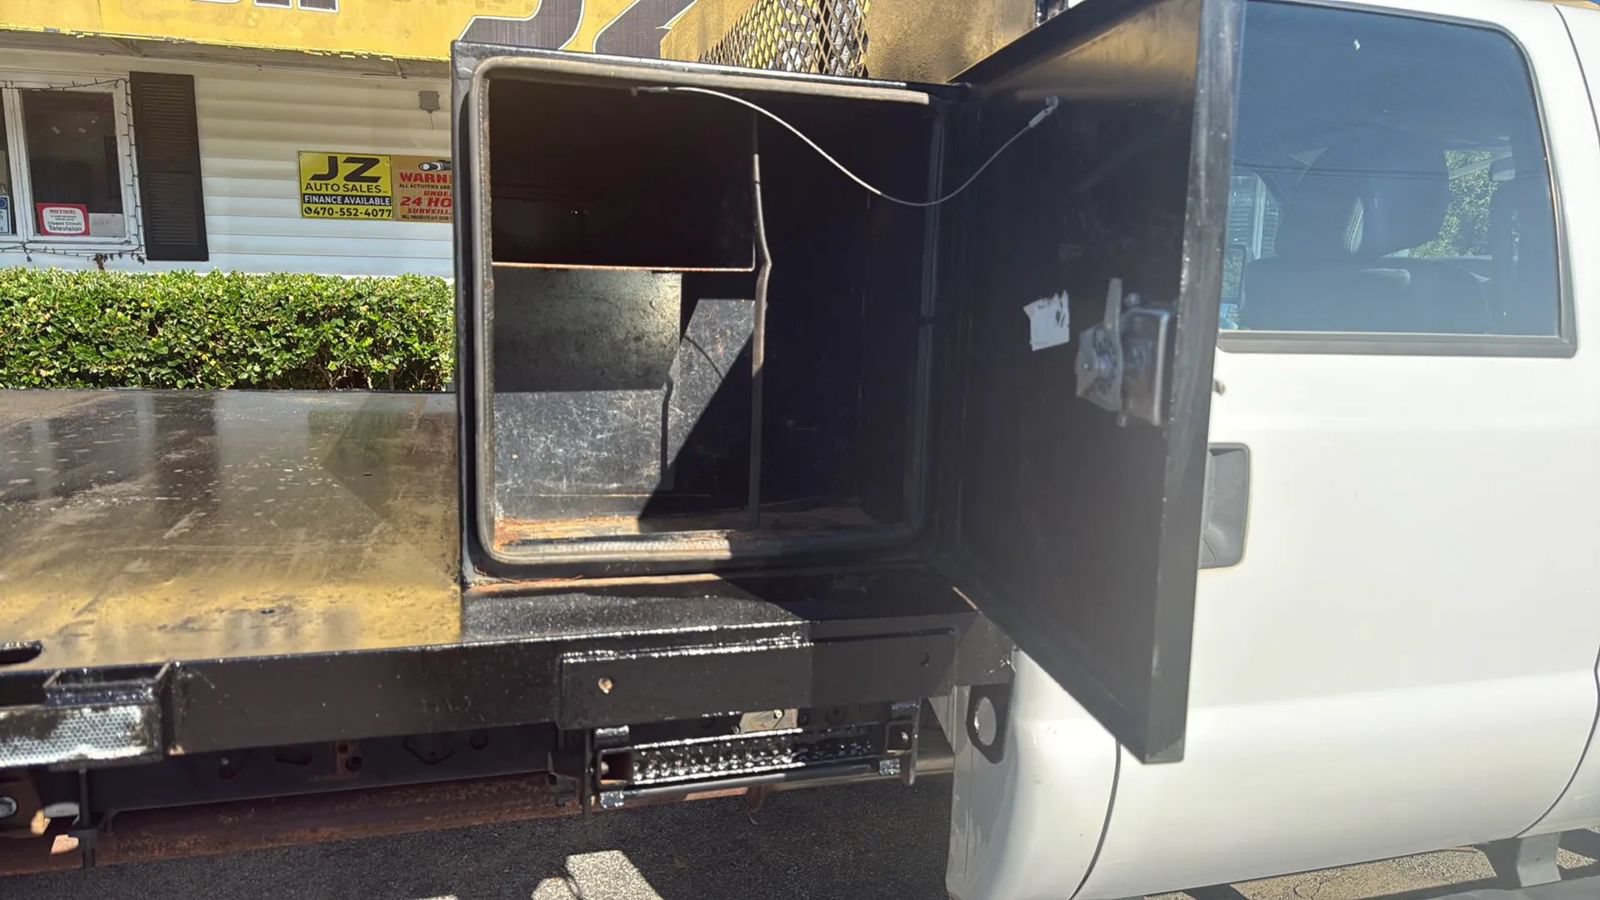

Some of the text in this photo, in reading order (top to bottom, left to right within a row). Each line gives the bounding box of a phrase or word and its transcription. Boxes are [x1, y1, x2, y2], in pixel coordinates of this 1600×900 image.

[309, 156, 381, 183] JZ
[305, 182, 381, 194] AUTO SALES
[304, 194, 390, 206] FINANCE AVAILABLE
[400, 196, 423, 207] 24
[313, 207, 392, 217] 470-552-4077
